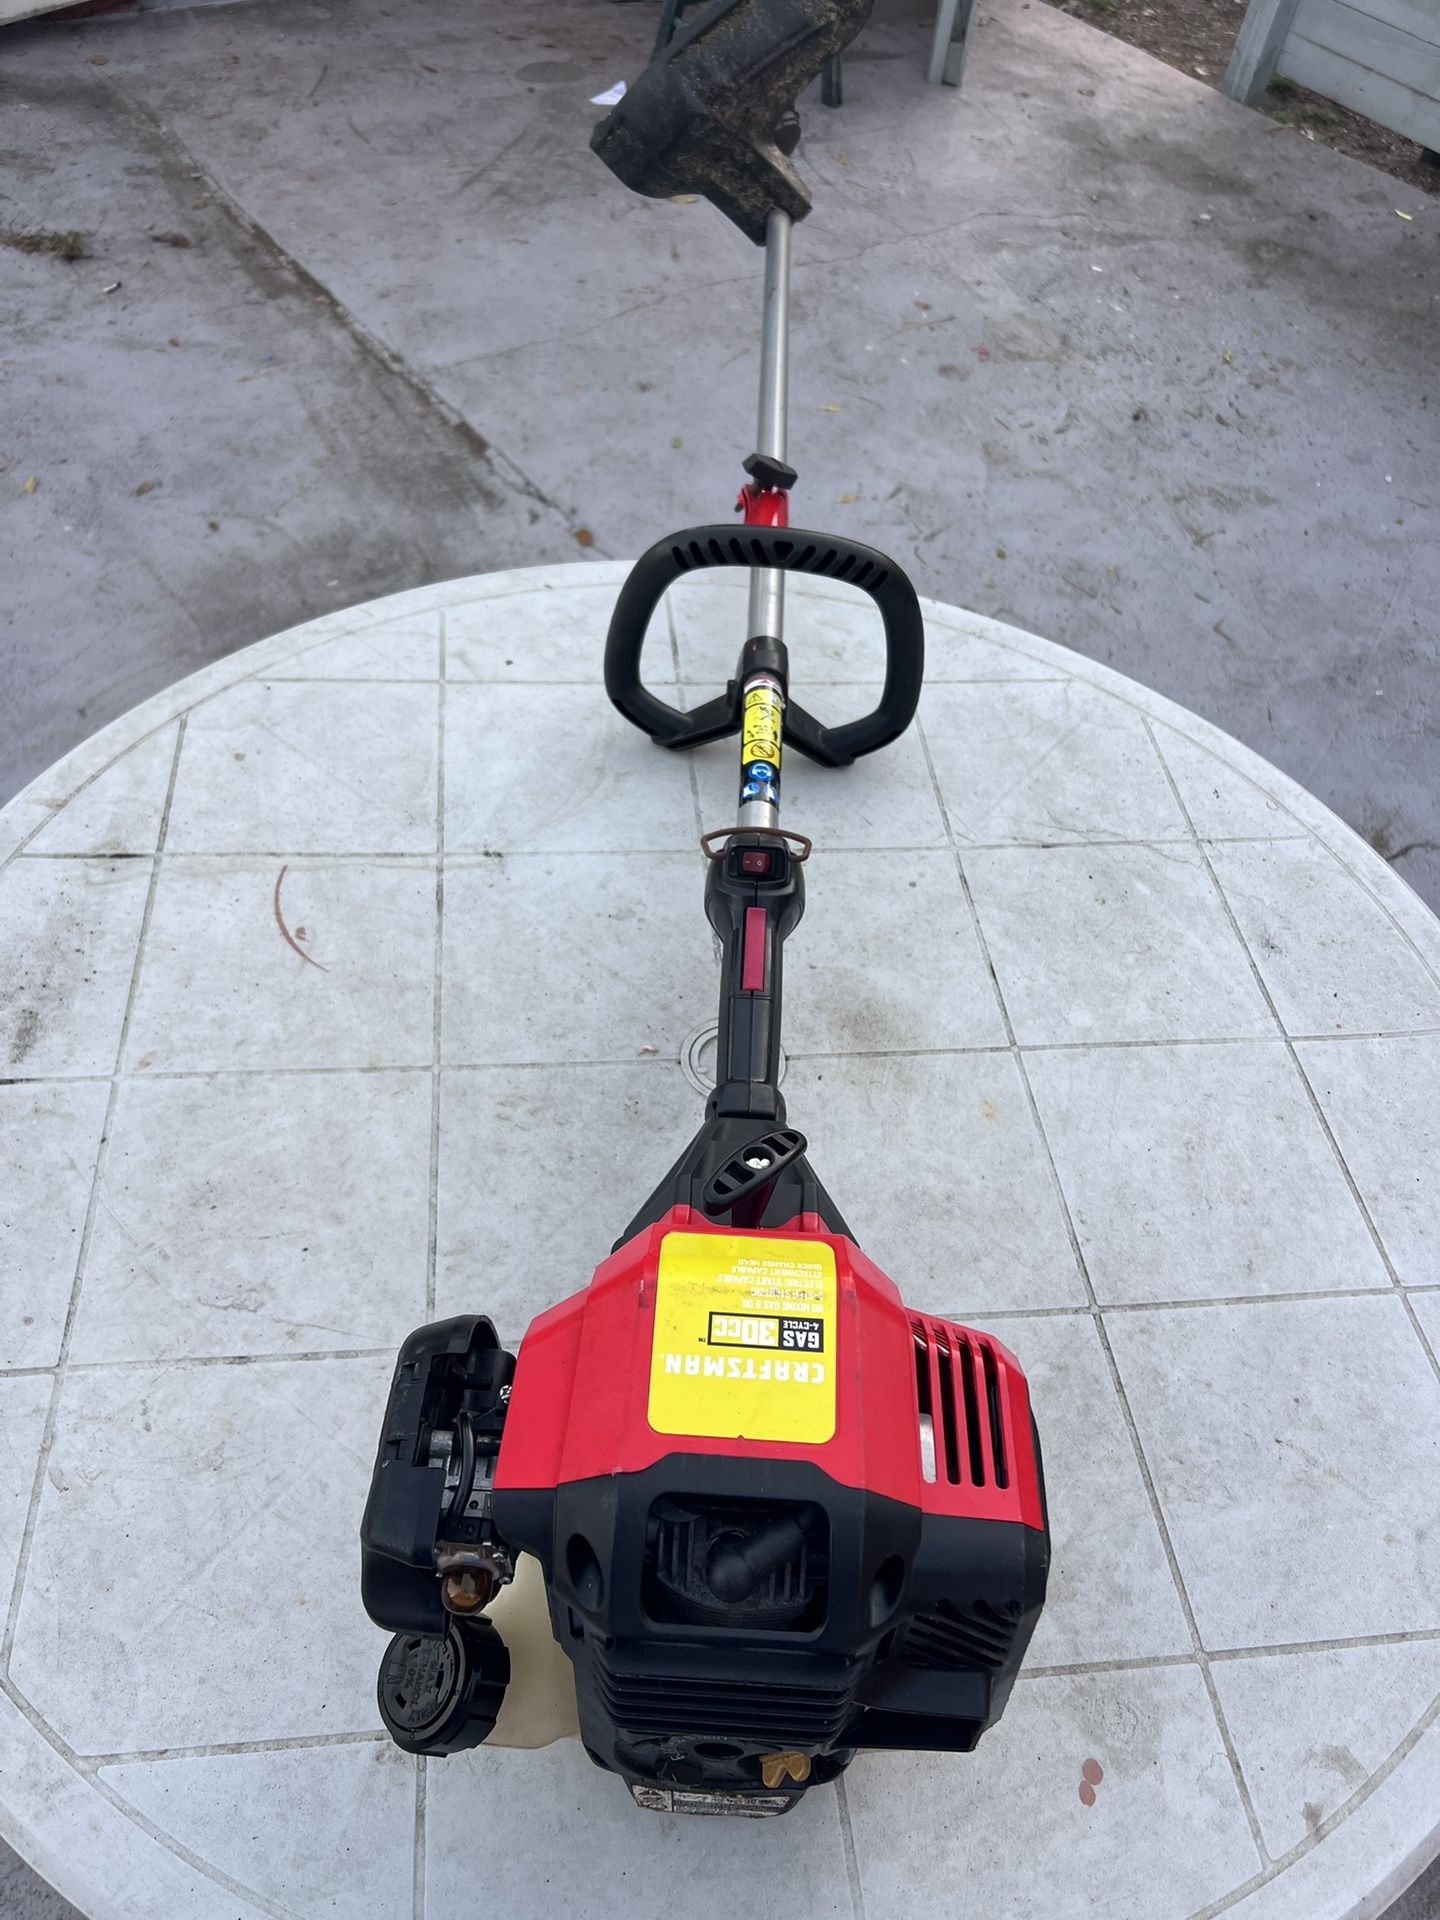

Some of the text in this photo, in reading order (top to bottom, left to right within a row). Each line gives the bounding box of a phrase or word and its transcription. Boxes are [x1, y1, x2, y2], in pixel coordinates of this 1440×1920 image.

[730, 1265, 823, 1279] ATTACHMENT CAPABLE
[716, 1274, 823, 1289] ELECTRIC START CAPABLE
[763, 1300, 781, 1311] GAS
[782, 1302, 811, 1312] MIXING
[783, 1319, 819, 1330] 4-CYCLE
[783, 1330, 820, 1349] GAS
[664, 1353, 825, 1384] CRAFTSMAN
